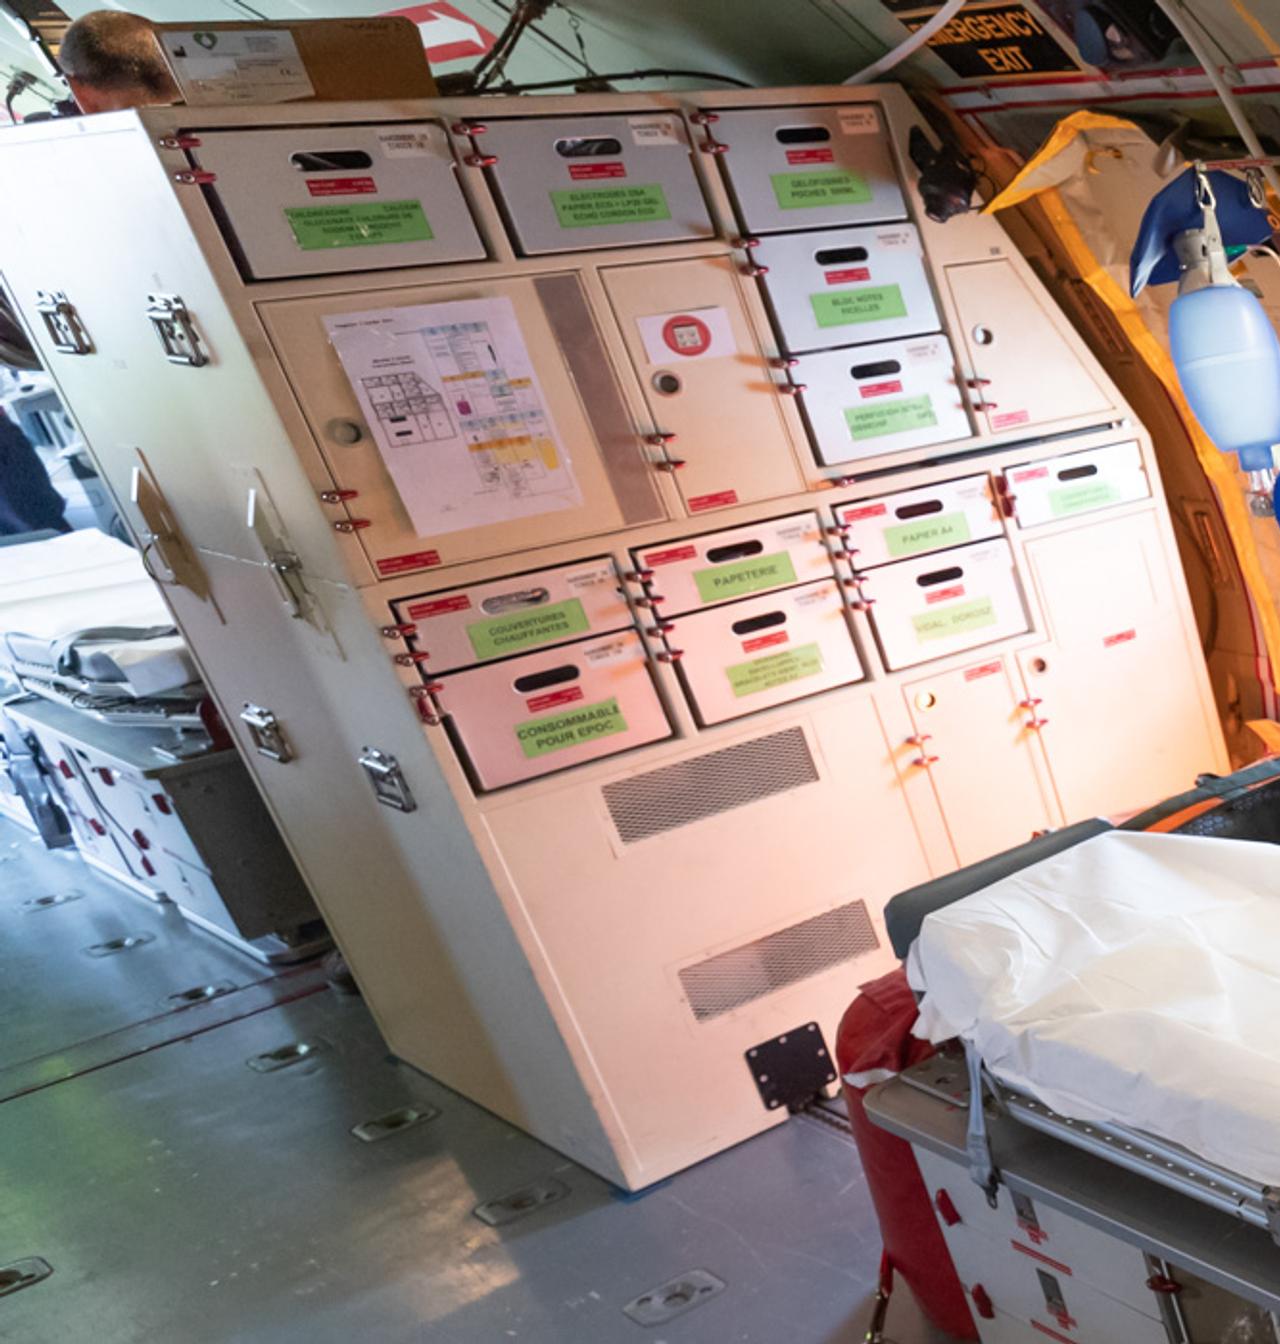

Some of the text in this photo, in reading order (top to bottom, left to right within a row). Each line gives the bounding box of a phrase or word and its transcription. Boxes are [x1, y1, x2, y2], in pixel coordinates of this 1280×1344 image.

[977, 46, 1033, 73] EXIT
[901, 529, 938, 545] PAPIER
[713, 564, 779, 587] PAPETERIE
[487, 611, 567, 636] COUVERTURES
[492, 620, 570, 646] CHAUFFANTES
[535, 720, 614, 749] POUR EPOC
